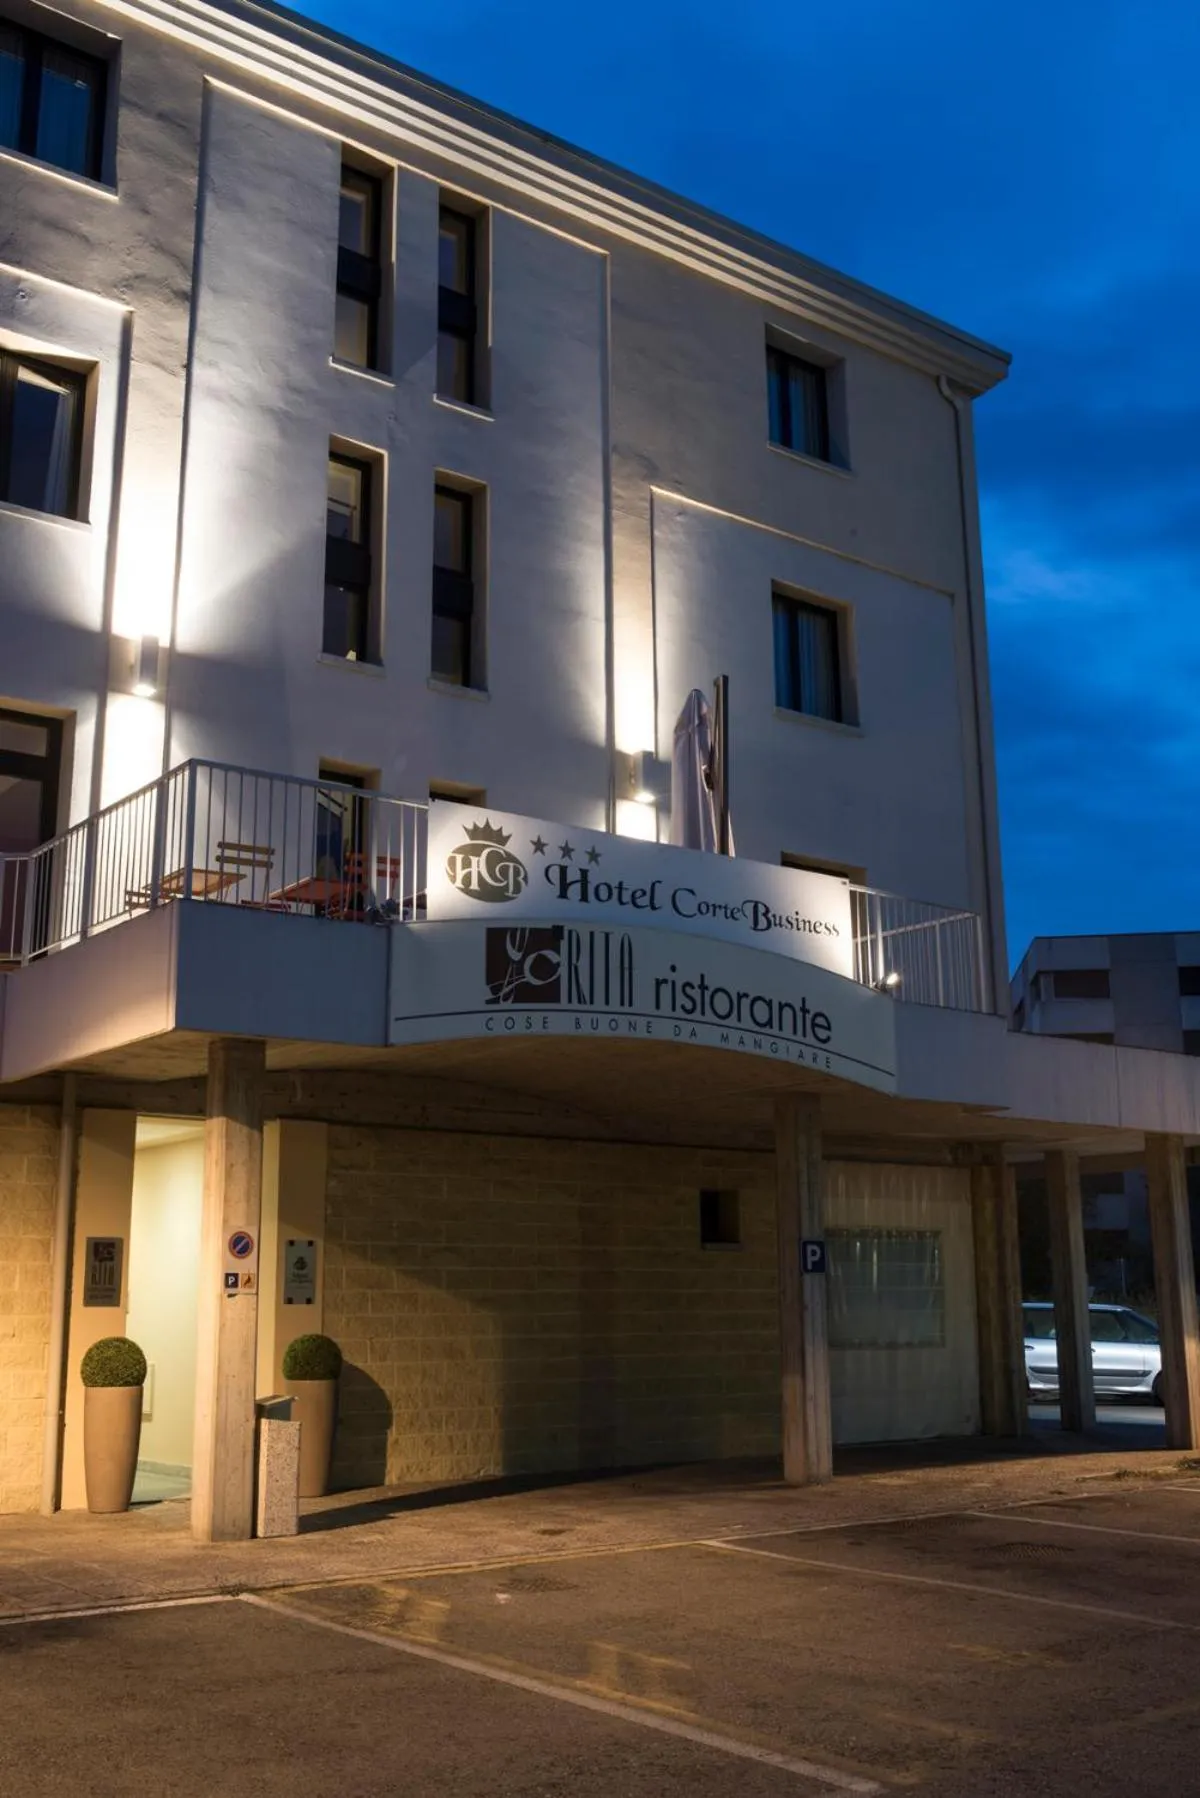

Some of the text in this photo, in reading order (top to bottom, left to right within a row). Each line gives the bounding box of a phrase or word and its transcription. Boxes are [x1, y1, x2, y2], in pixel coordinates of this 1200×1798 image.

[544, 863, 841, 937] Hotel Corte Business
[654, 963, 833, 1045] ristorante
[484, 1015, 833, 1070] COSE BUONE DA MANGIARE
[228, 1275, 236, 1286] P
[806, 1244, 821, 1271] P
